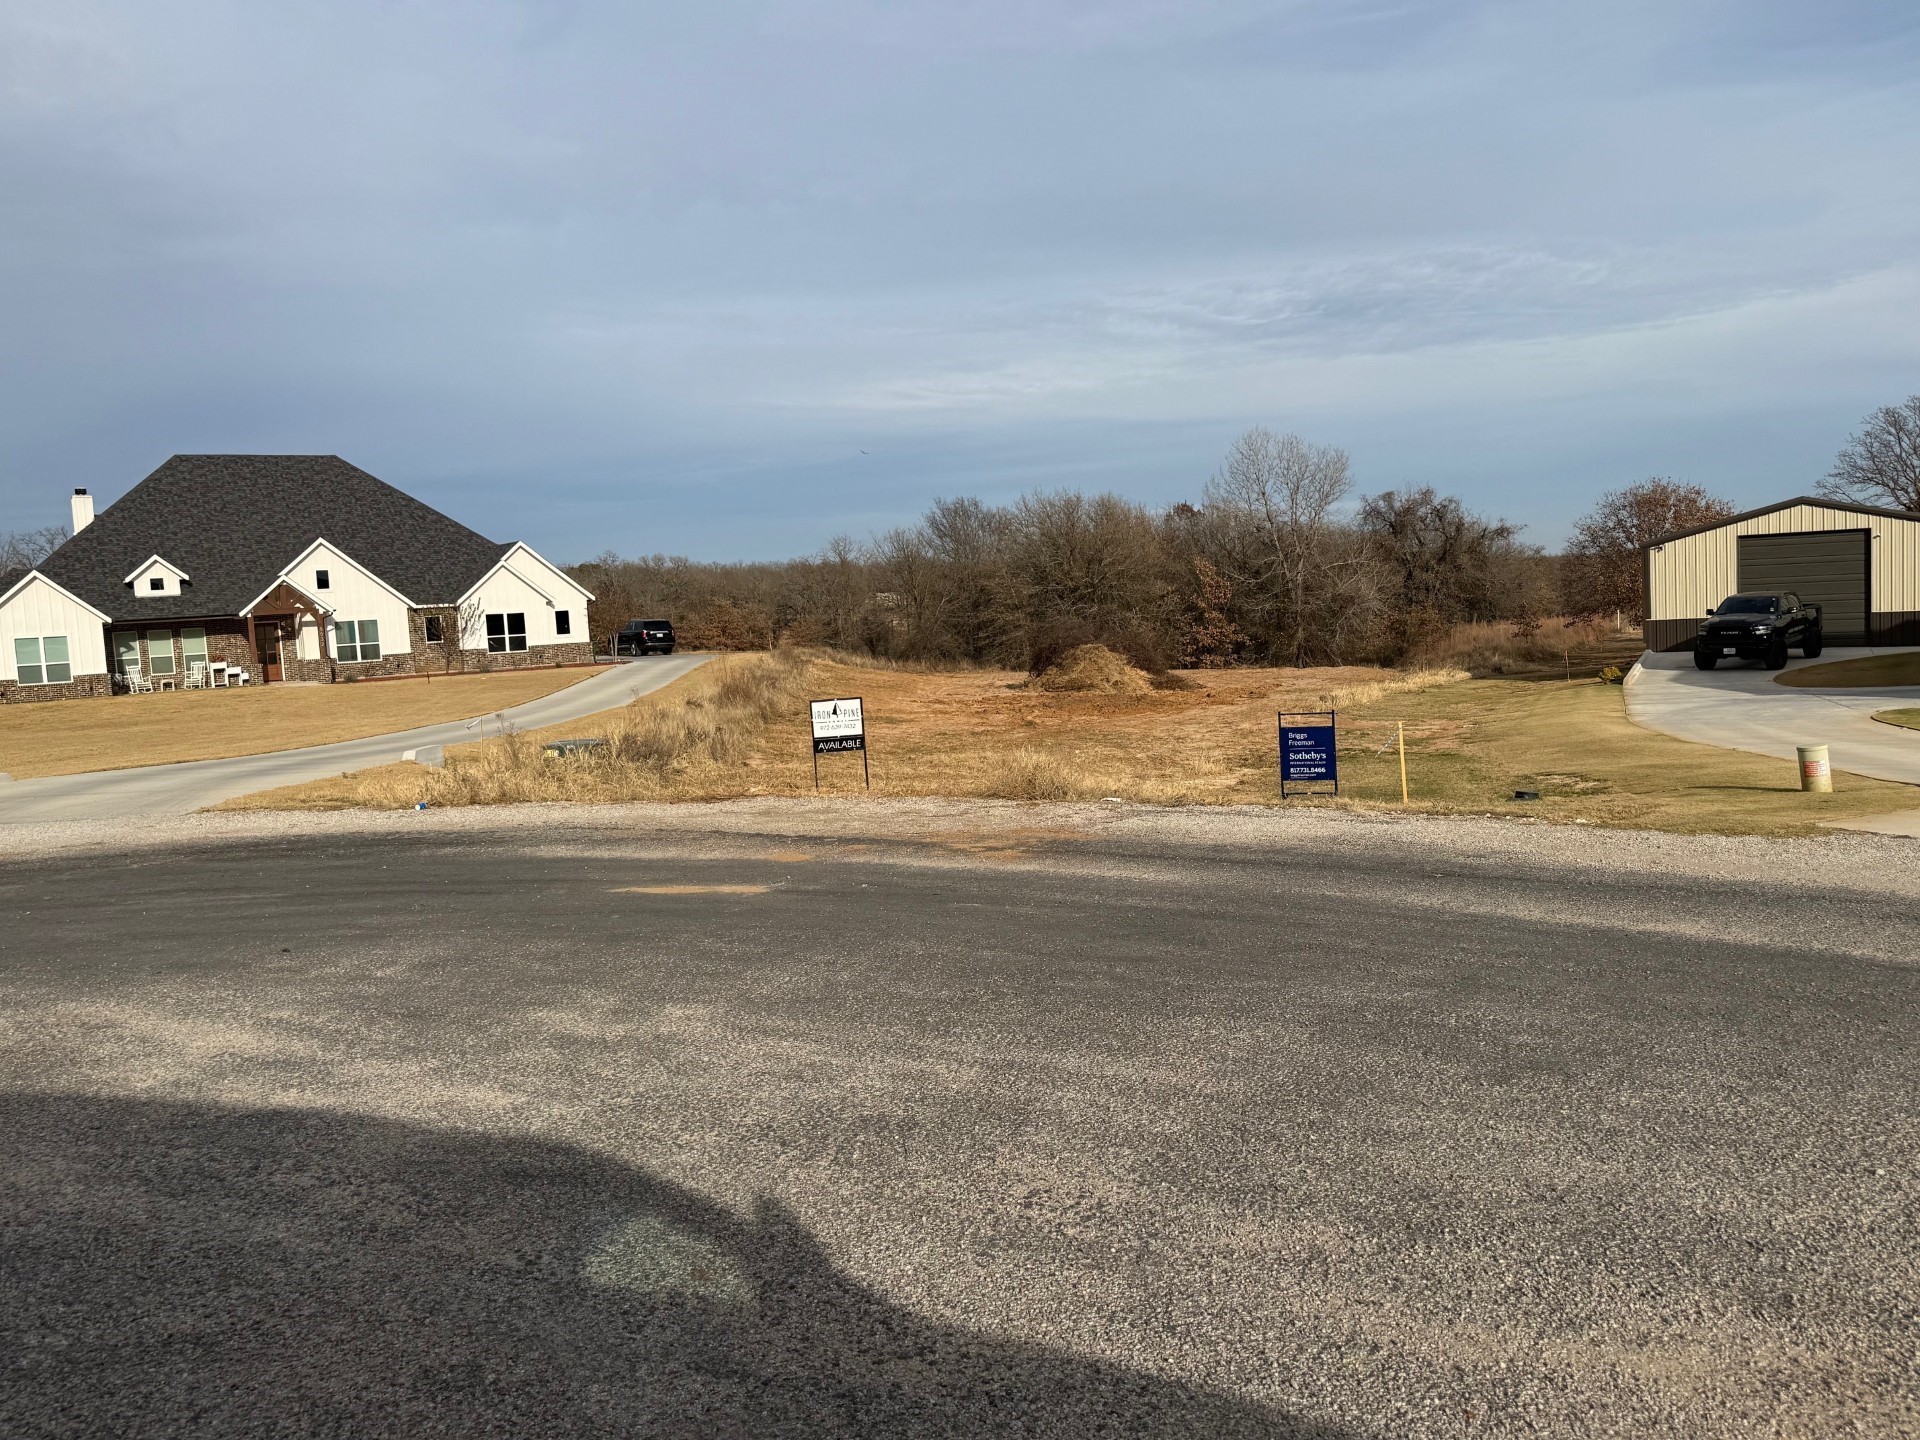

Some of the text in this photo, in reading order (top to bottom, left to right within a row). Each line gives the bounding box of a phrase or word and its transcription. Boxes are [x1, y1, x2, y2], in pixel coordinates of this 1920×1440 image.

[814, 708, 860, 720] IRON PINE
[818, 739, 862, 750] AVAILABLE
[1289, 751, 1327, 761] Sotheby's
